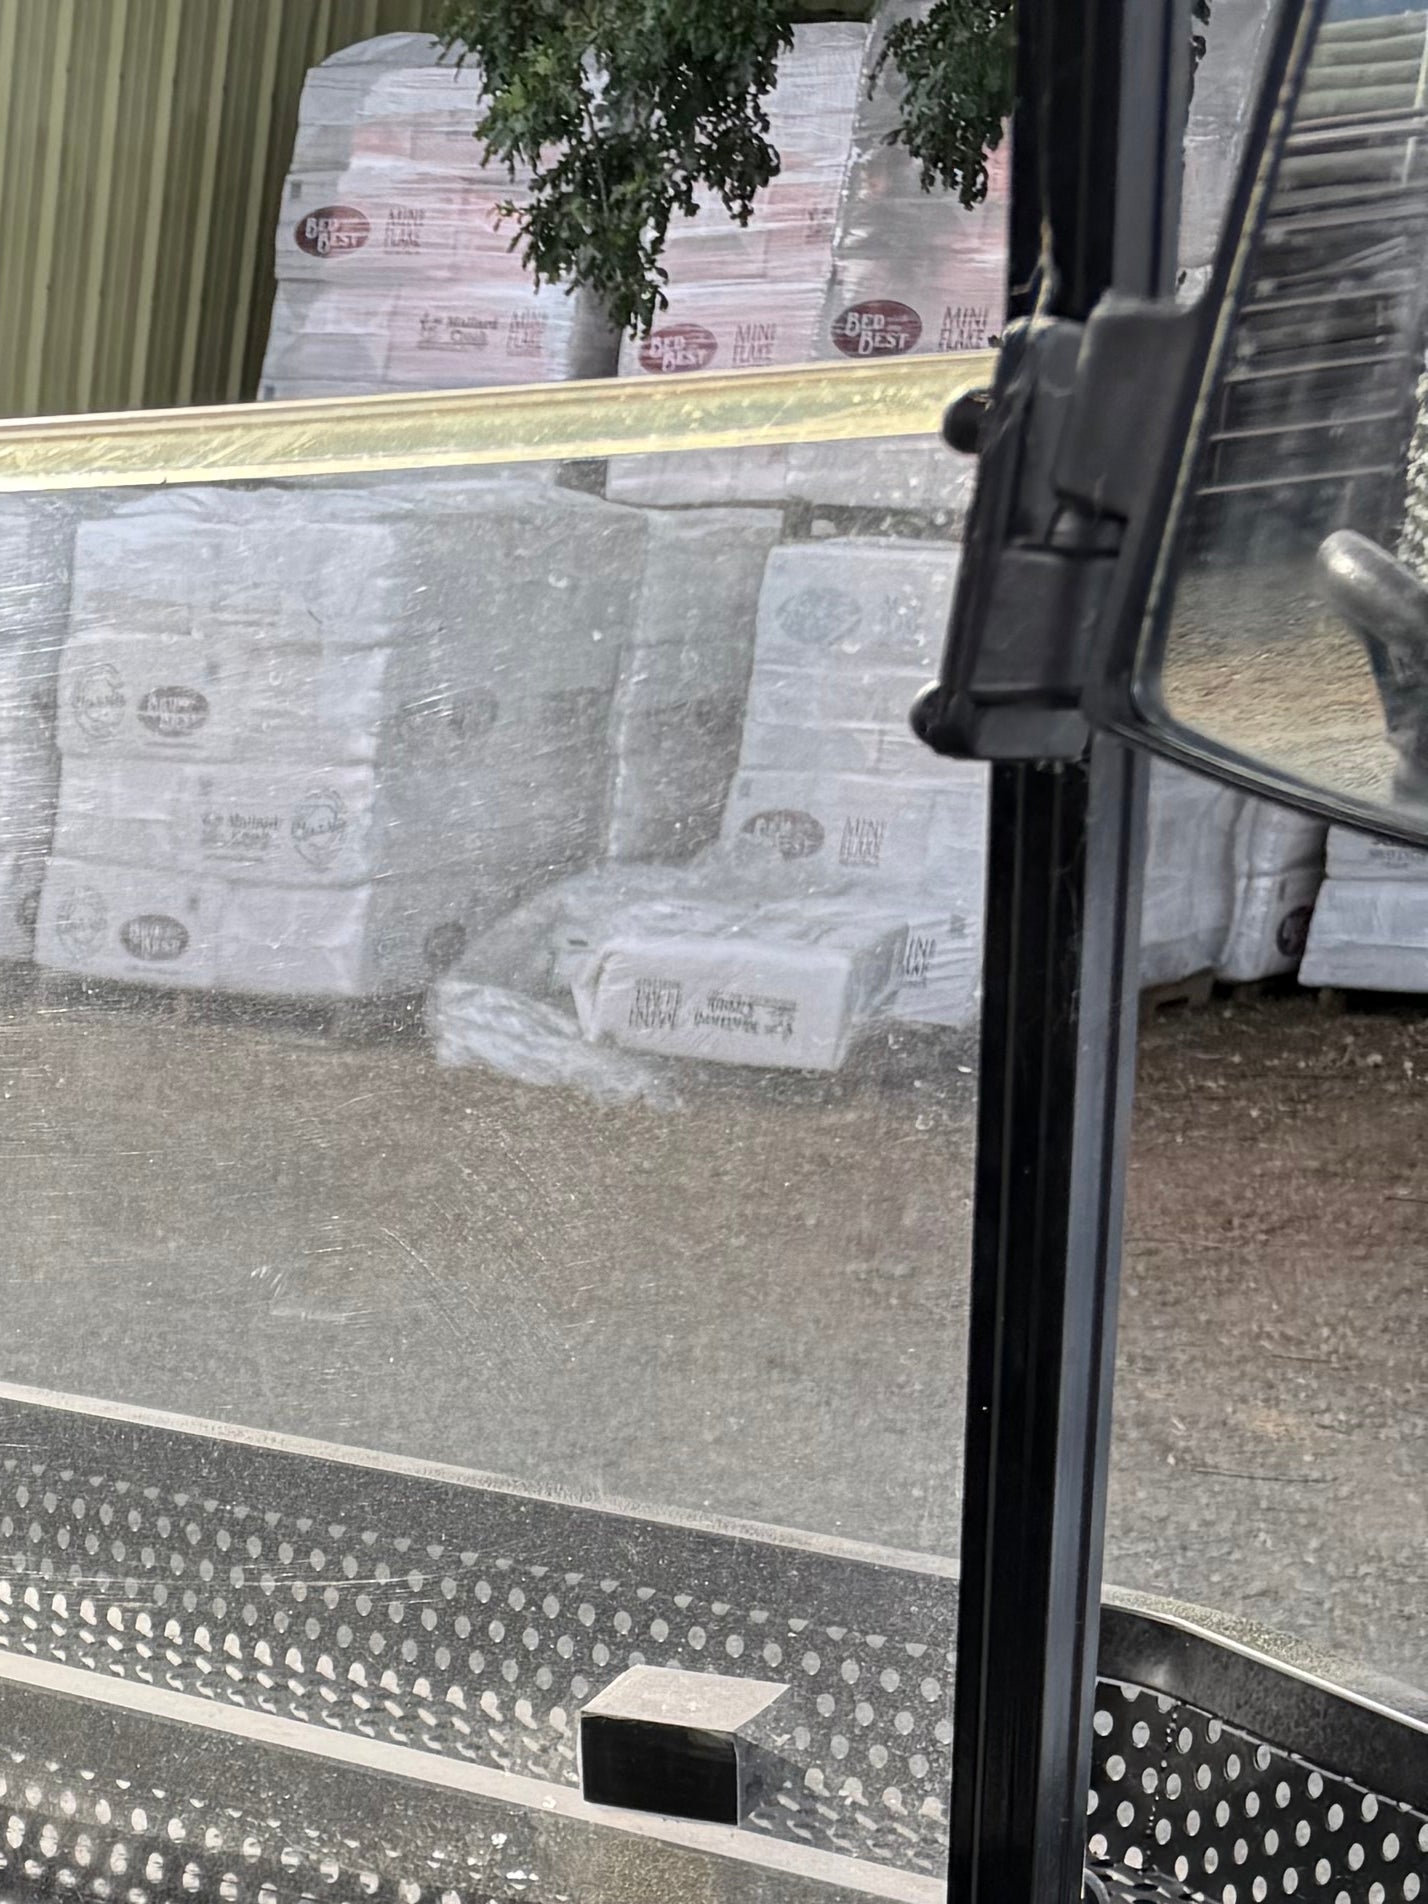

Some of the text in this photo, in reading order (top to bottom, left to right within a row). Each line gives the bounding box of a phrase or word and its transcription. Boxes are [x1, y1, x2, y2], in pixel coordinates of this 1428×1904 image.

[305, 217, 341, 239] BED
[317, 232, 363, 254] BEST
[844, 312, 885, 337] BED
[944, 306, 989, 328] MINI
[736, 323, 776, 342] MINI
[857, 330, 910, 355] BEST
[938, 328, 986, 350] FLAKE
[649, 335, 685, 358] BED
[662, 347, 708, 372] BEST
